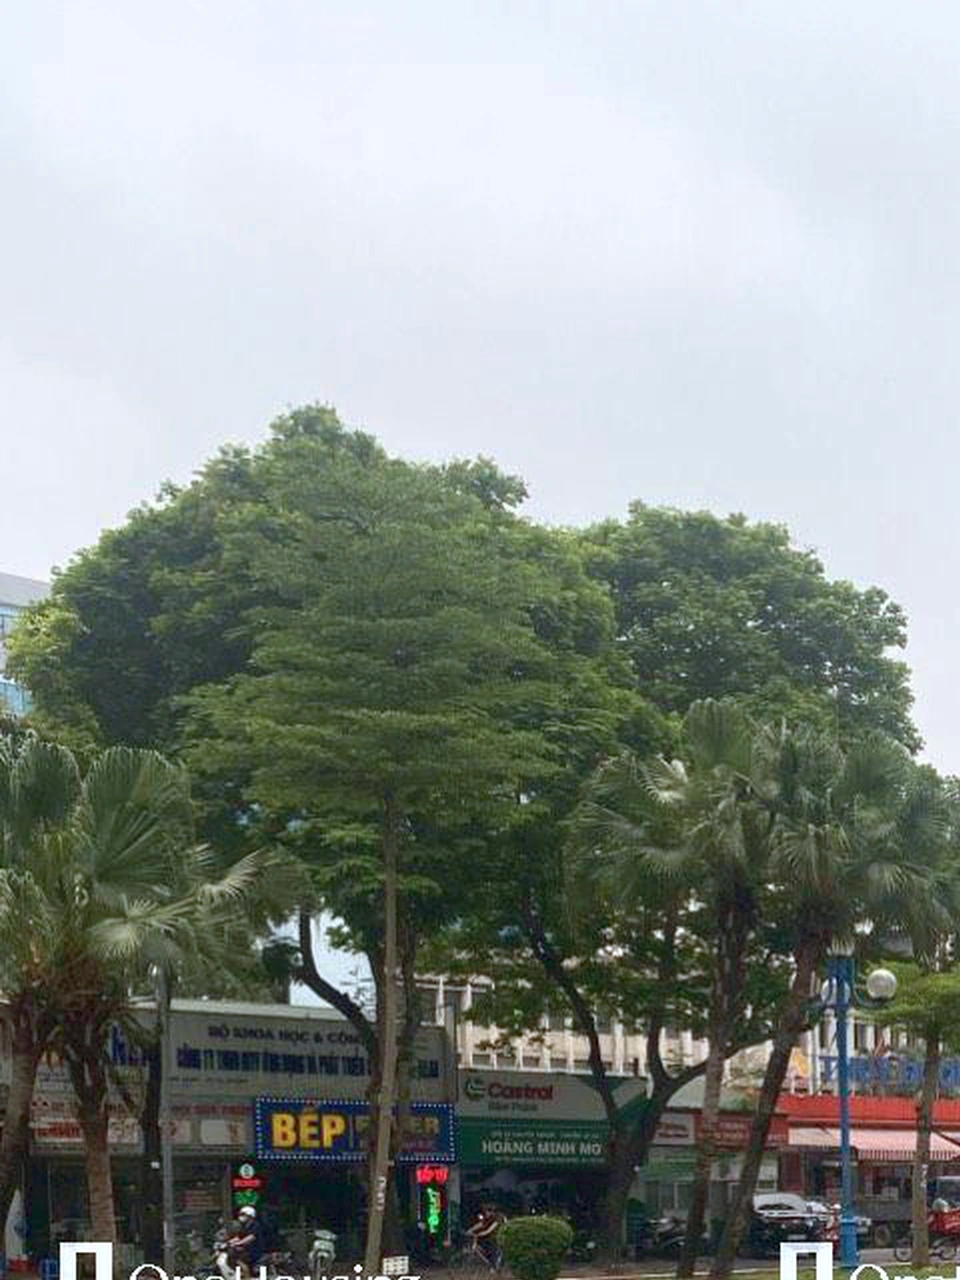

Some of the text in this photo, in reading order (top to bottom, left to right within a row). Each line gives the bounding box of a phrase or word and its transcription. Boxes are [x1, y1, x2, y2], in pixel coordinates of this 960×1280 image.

[233, 1026, 275, 1041] KHOA
[278, 1028, 310, 1047] HỌC
[488, 1081, 554, 1100] Castrol
[537, 1141, 576, 1156] MINH
